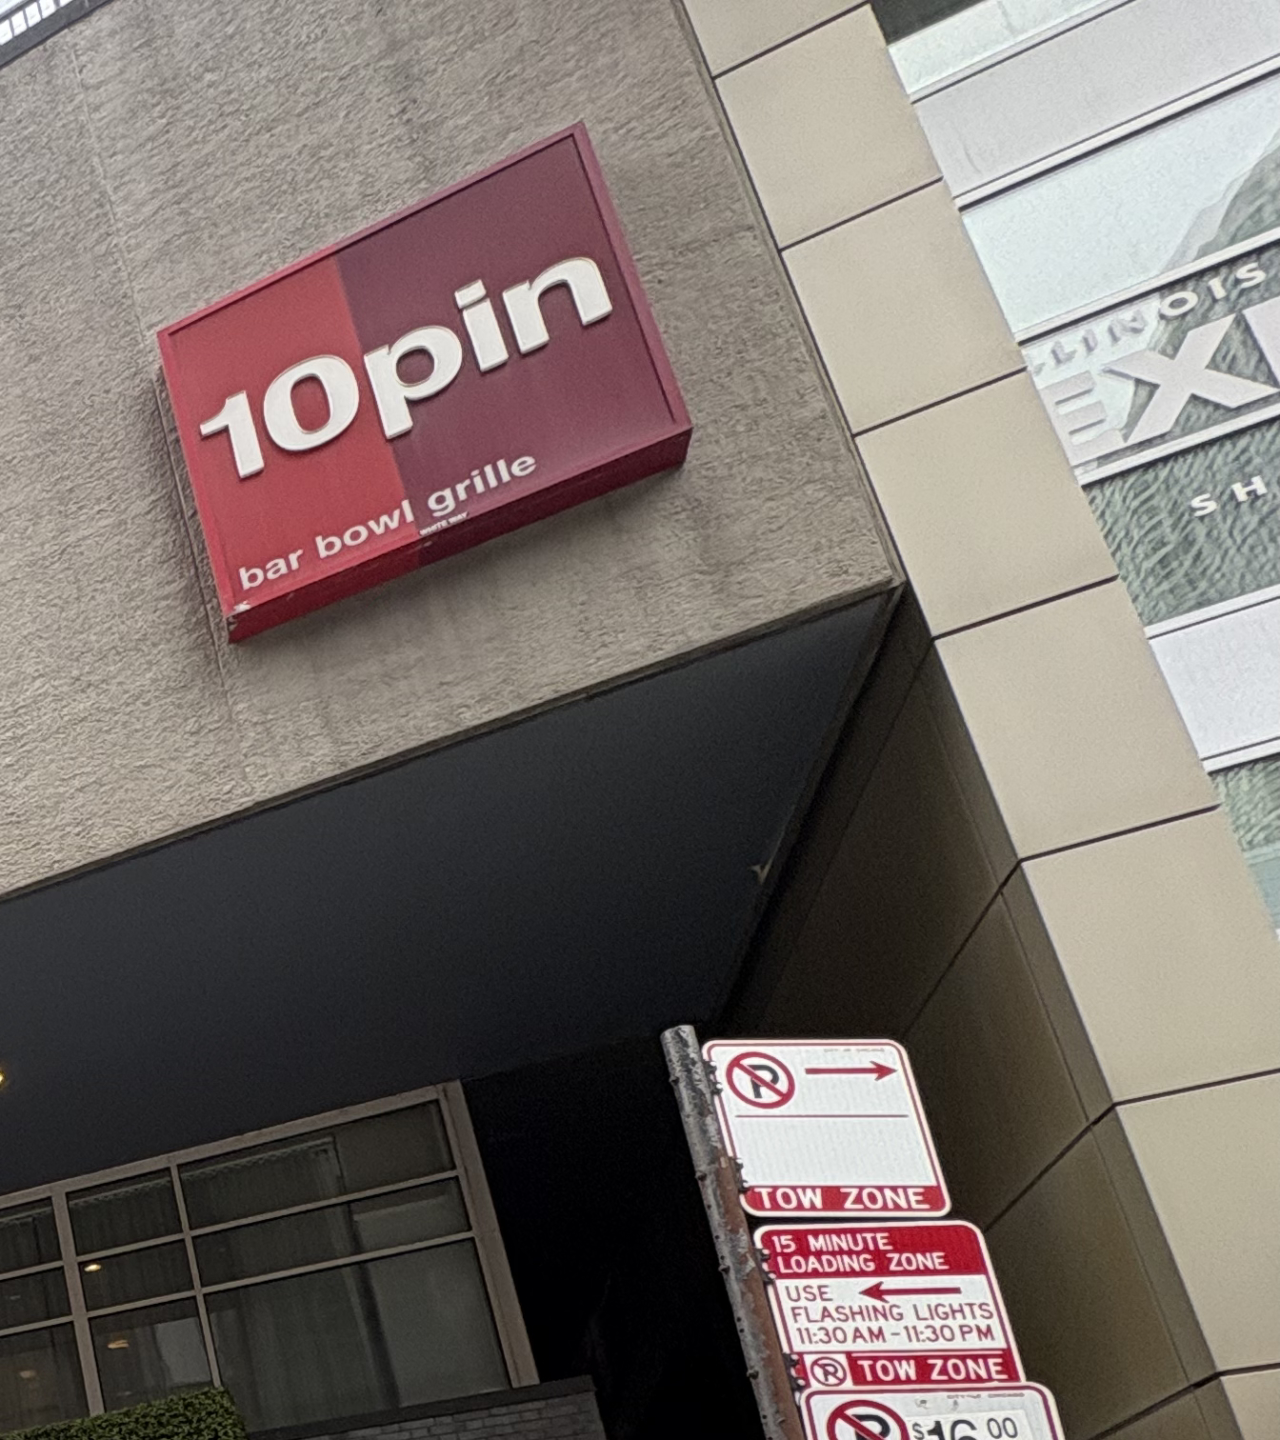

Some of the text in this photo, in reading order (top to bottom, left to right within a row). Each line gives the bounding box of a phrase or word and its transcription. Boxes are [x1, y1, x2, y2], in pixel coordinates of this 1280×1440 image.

[1032, 261, 1267, 377] LINOIS
[198, 255, 614, 481] 10pin
[238, 455, 537, 591] bar bowl grille
[754, 1187, 931, 1209] TOW ZONE
[771, 1232, 893, 1253] 15 MINUTE
[777, 1252, 949, 1274] LOADING ZONE
[784, 1284, 833, 1302] USE
[790, 1302, 994, 1324] FLASHING LIGHTS
[796, 1326, 847, 1344] 11:30
[857, 1358, 1009, 1381] TOW ZONE
